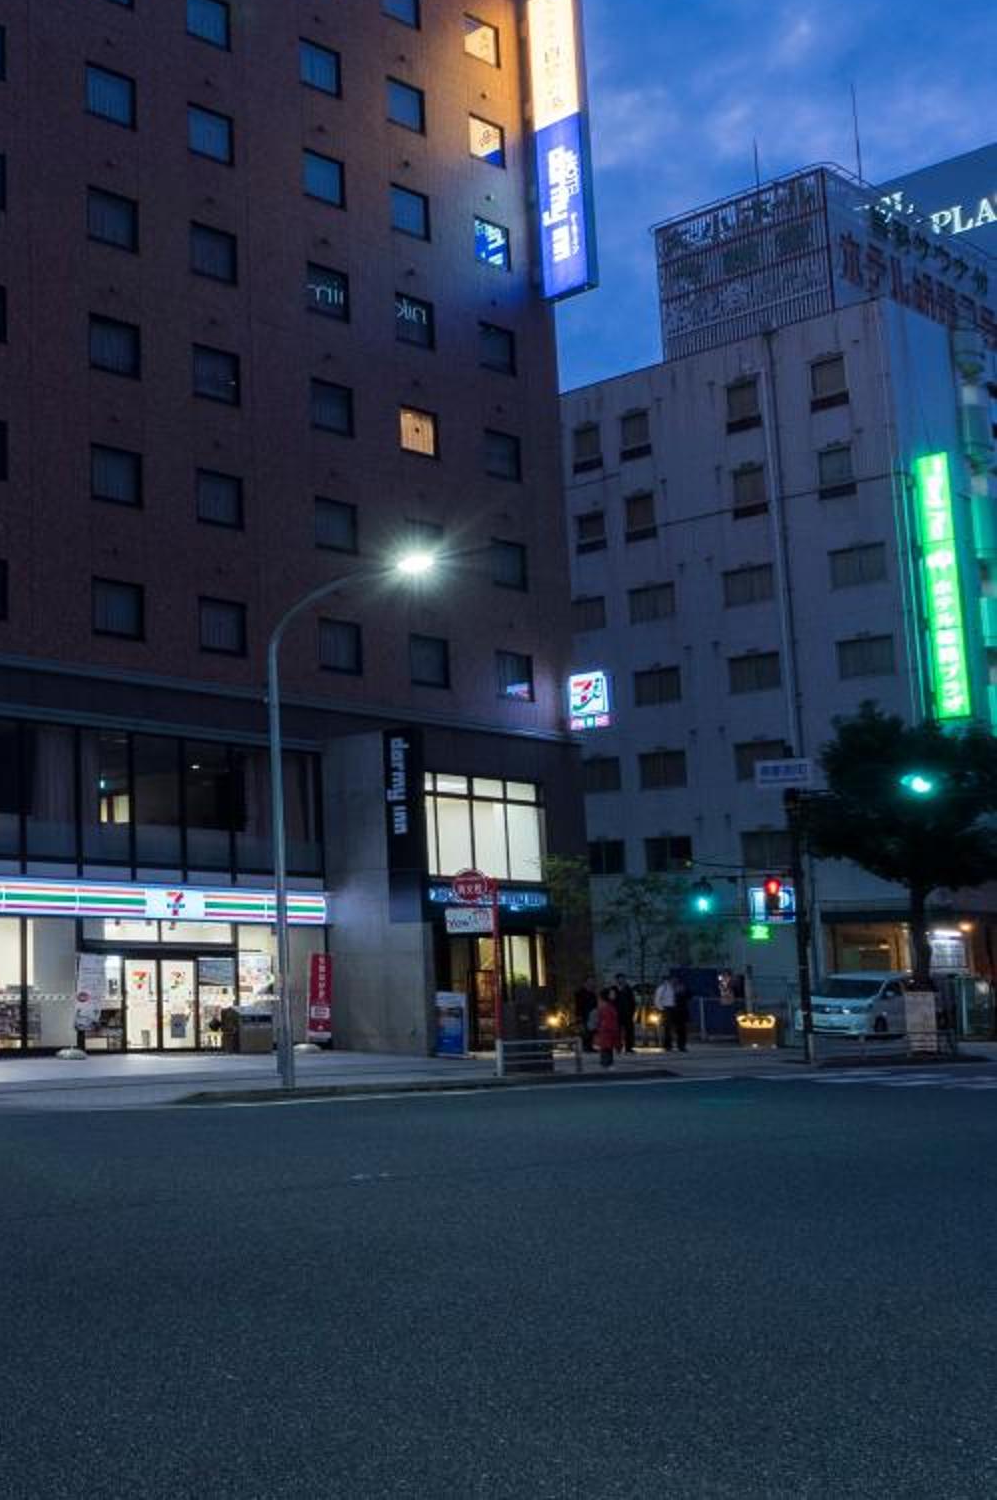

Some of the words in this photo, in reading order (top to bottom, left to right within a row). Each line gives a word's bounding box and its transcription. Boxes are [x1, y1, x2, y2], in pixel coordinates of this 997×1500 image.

[930, 192, 997, 235] PLA
[386, 737, 410, 803] dormy
[393, 805, 410, 836] inn
